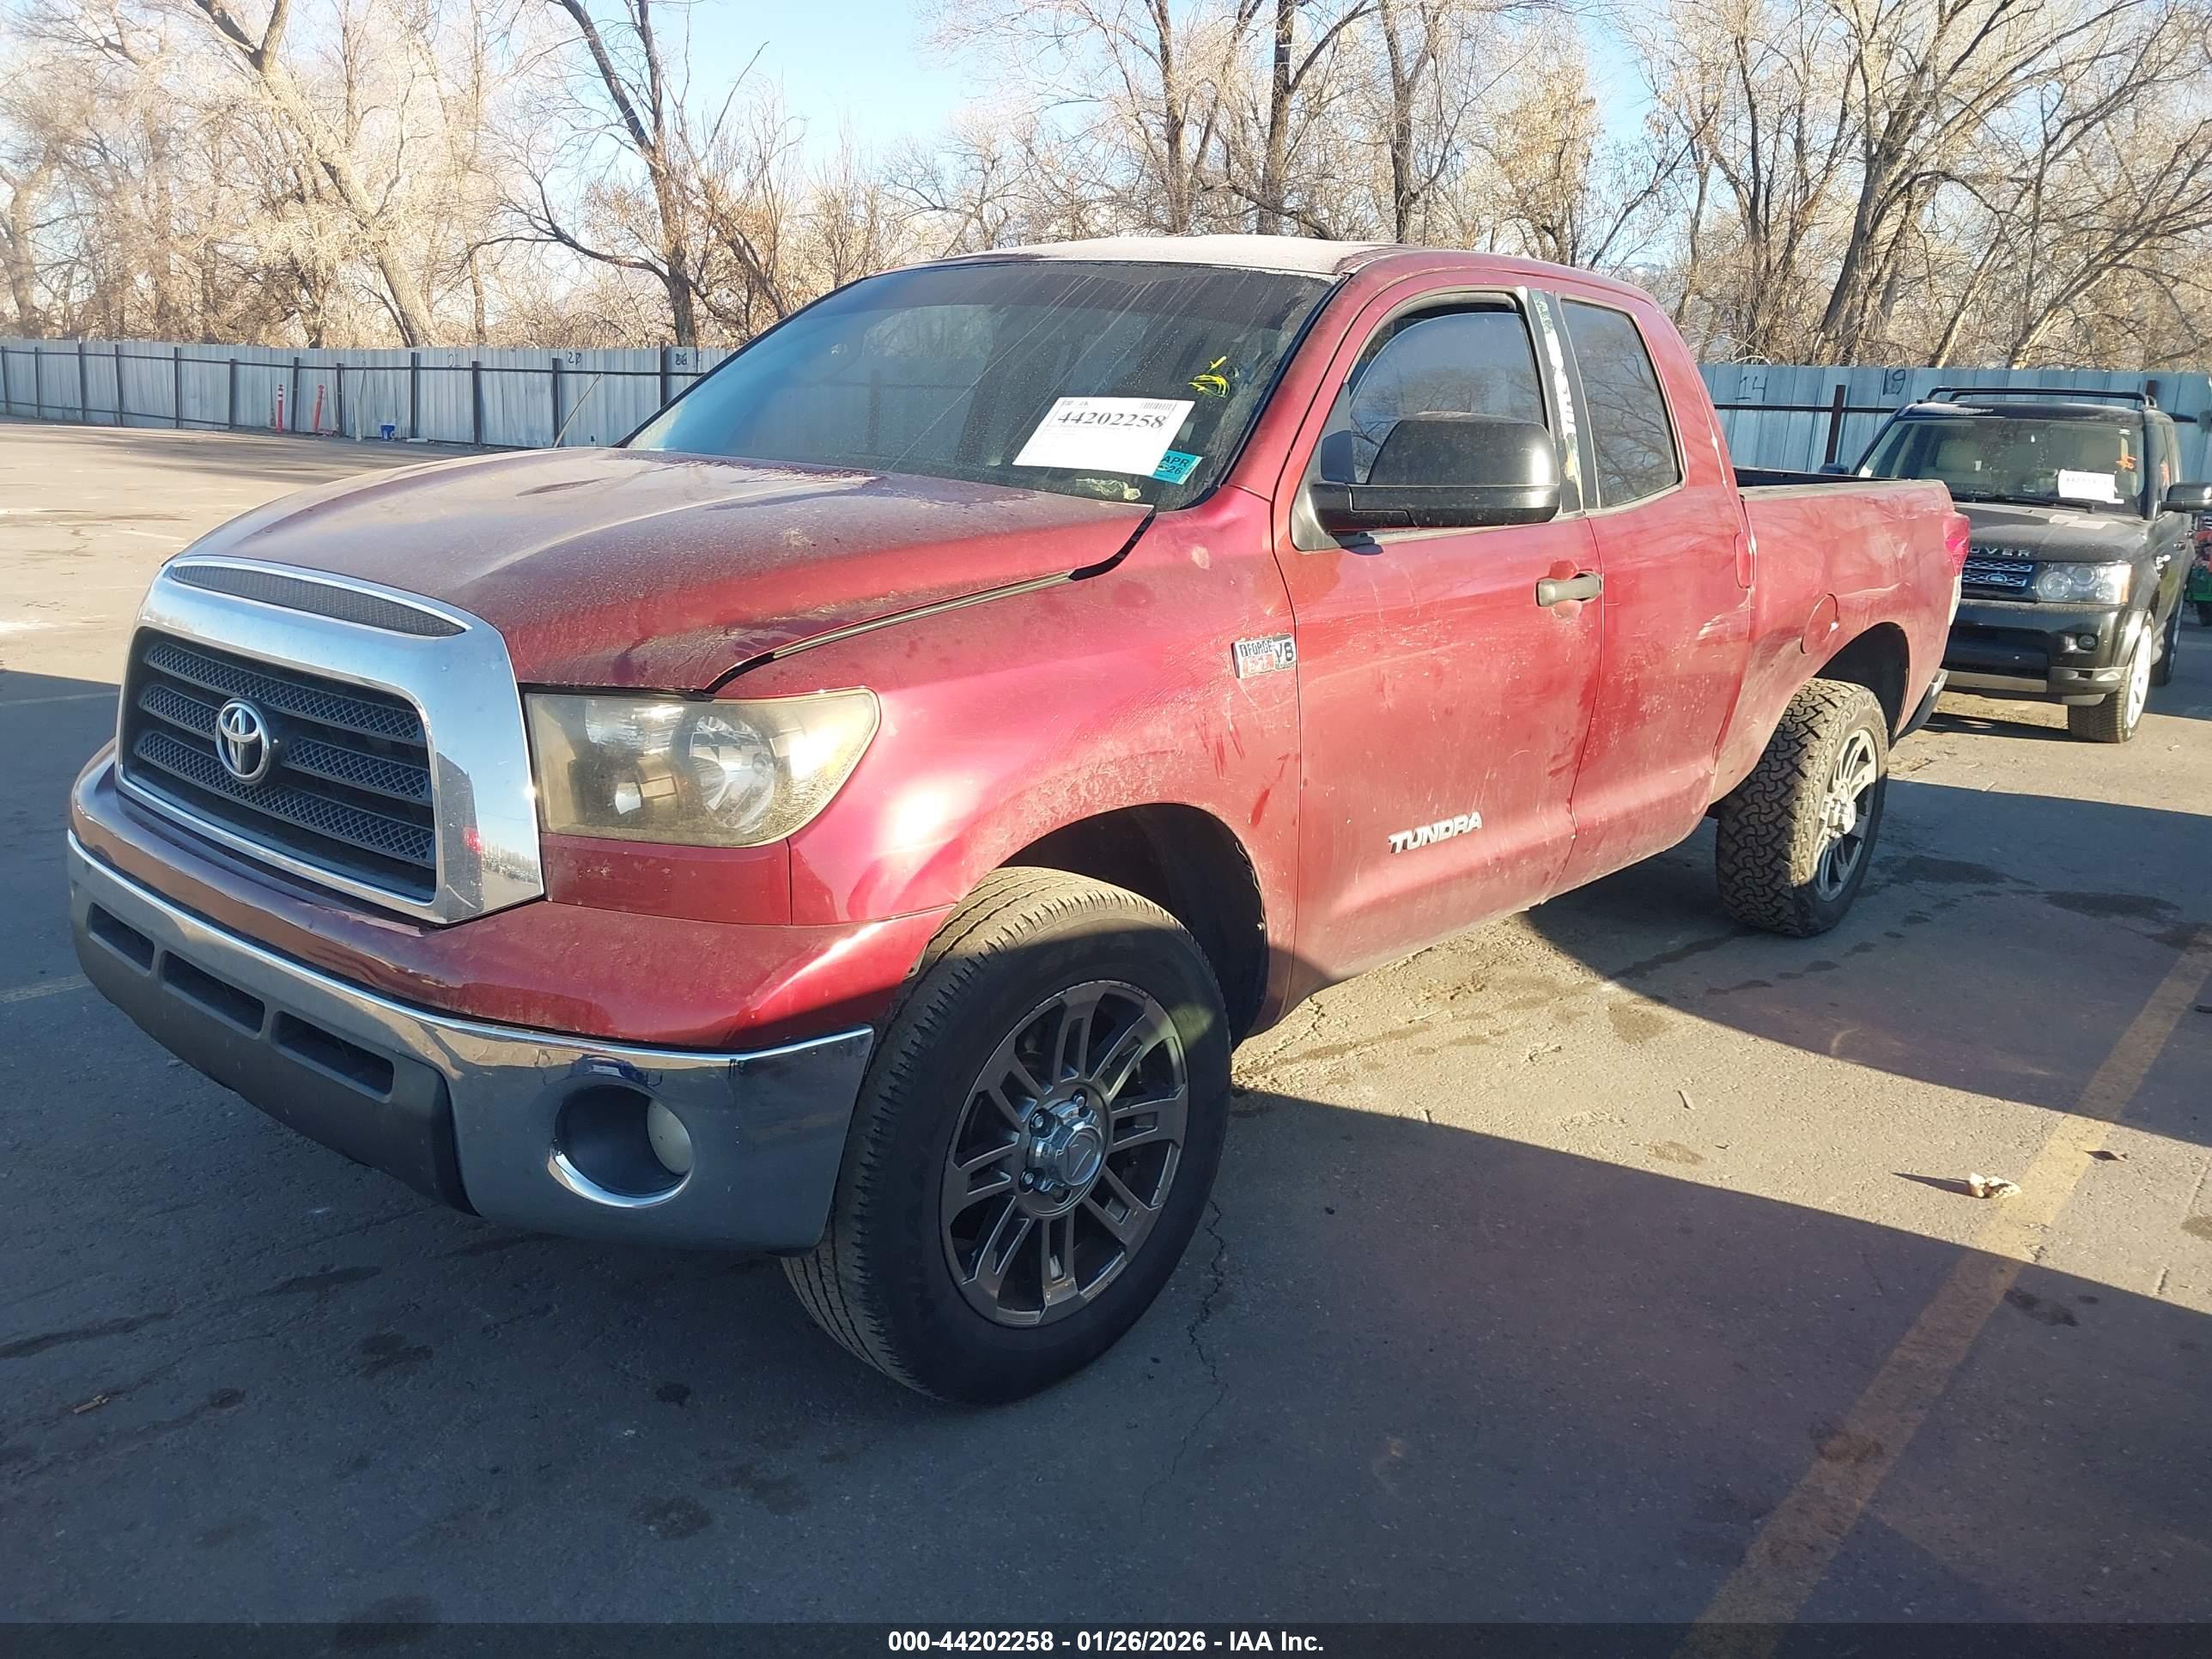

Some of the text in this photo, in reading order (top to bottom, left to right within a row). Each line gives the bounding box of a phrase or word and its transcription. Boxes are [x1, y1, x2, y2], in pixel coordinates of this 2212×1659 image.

[1882, 368, 1906, 396] 19
[1057, 410, 1167, 429] 44202258
[1161, 455, 1189, 467] APR
[1275, 641, 1294, 664] V8
[1388, 811, 1483, 854] TUNDRA
